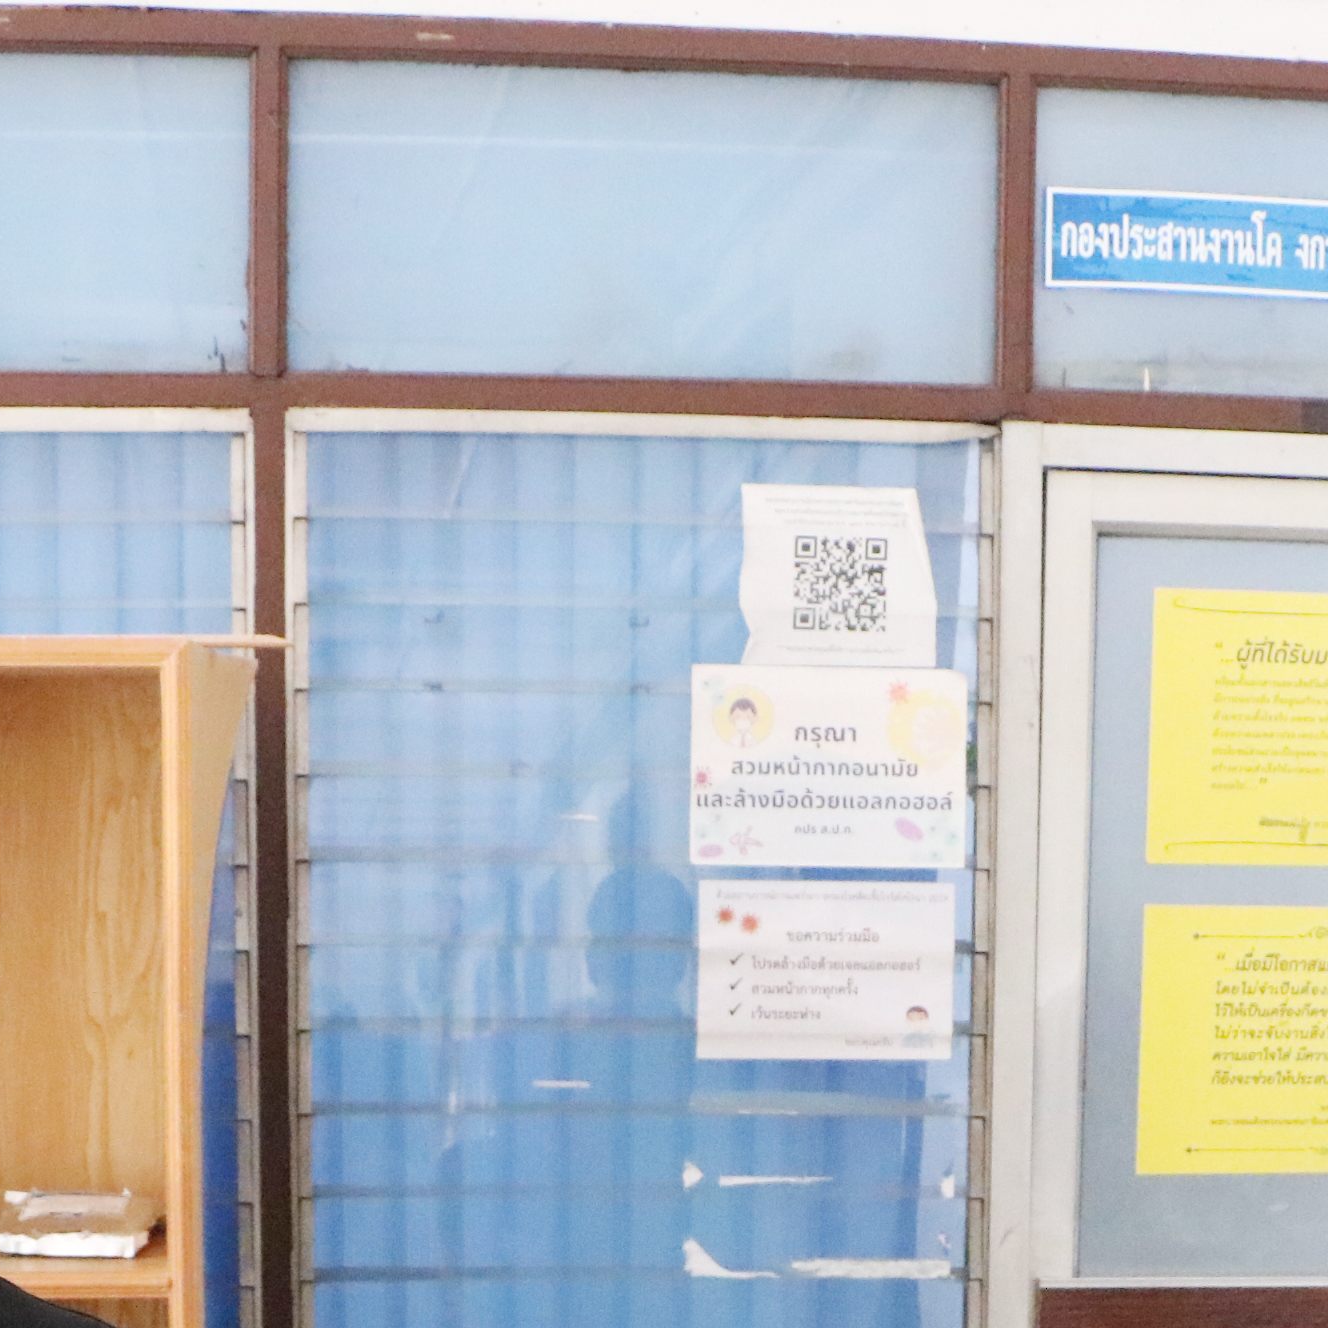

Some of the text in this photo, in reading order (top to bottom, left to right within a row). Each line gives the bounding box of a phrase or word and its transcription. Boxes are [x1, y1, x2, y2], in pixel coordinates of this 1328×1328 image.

[794, 724, 858, 749] กรุณา
[730, 755, 919, 779] สวมหน้ากากอนามัย
[696, 788, 953, 812] และล้างมือด้วยแอลกอฮอล์
[786, 927, 880, 945] ขอความร่วมมือ
